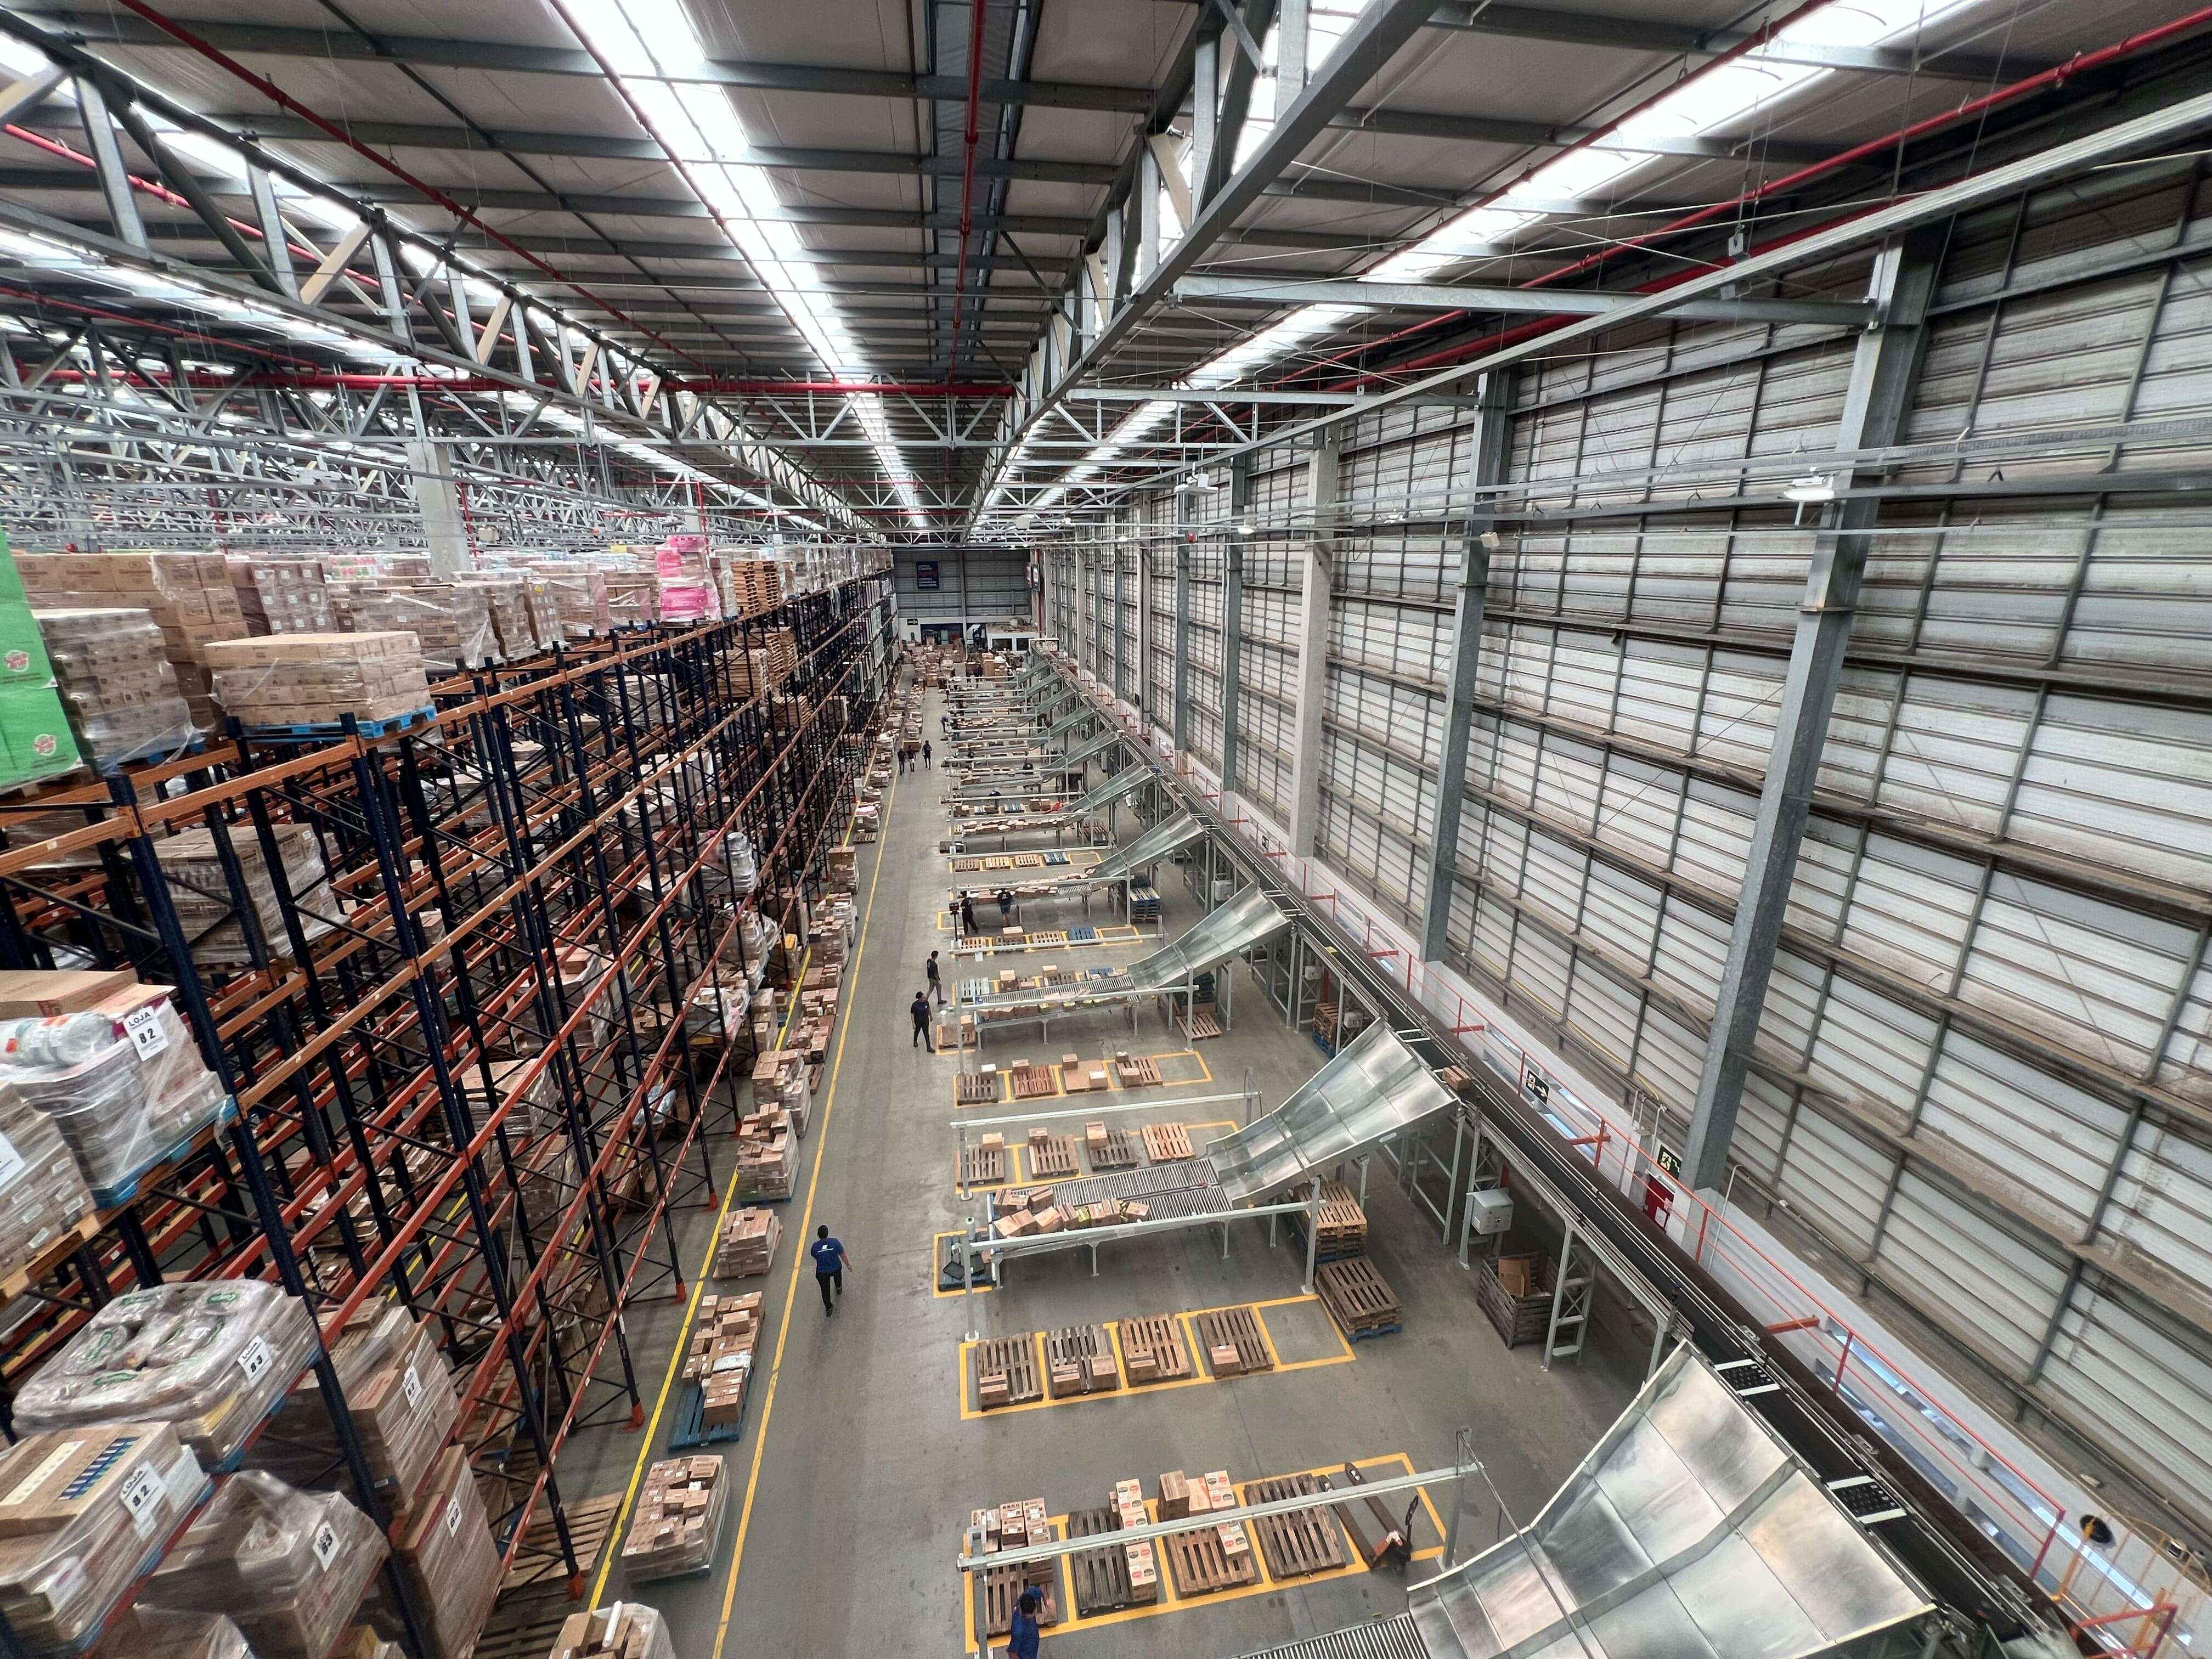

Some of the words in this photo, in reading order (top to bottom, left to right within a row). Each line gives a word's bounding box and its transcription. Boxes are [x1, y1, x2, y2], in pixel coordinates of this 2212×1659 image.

[128, 1012, 151, 1026] LOJA
[139, 1028, 156, 1043] 82
[122, 1470, 143, 1494] LOJA
